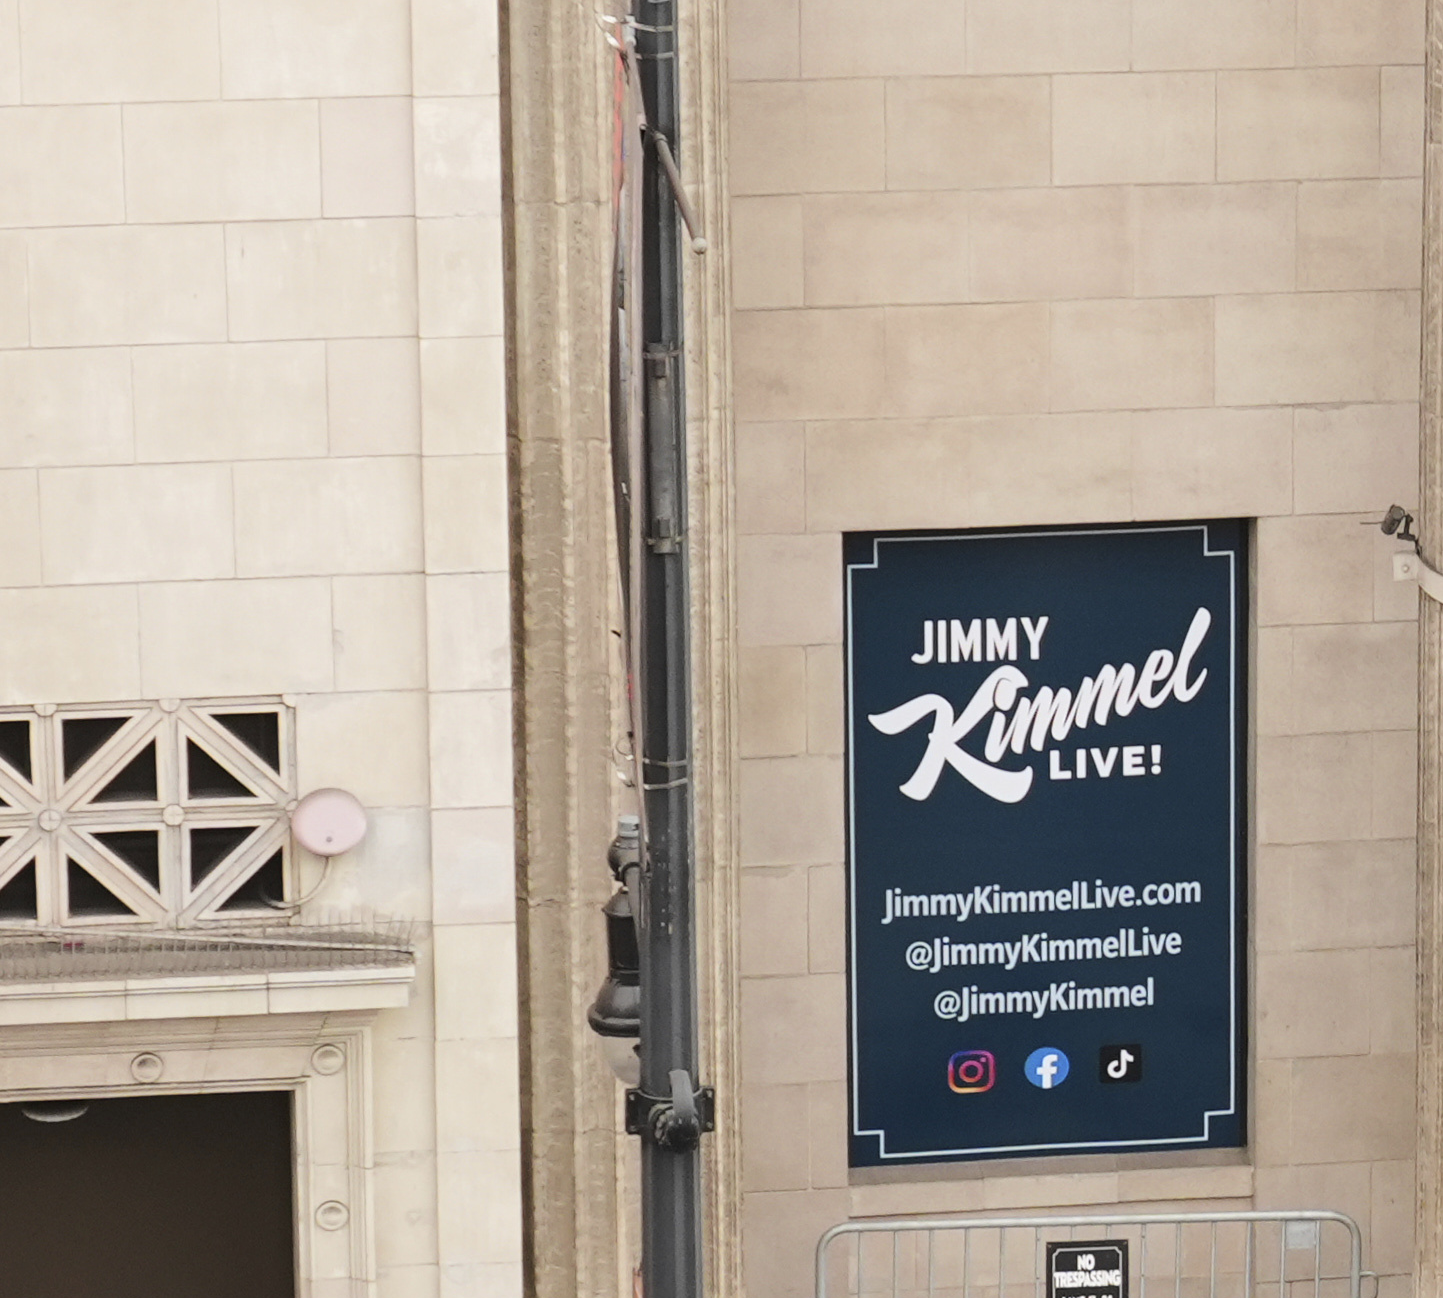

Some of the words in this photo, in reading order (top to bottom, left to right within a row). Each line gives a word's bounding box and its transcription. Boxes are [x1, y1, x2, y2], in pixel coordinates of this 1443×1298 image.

[910, 615, 1050, 666] JIMMY
[868, 607, 1212, 804] Kimmel
[1048, 744, 1163, 781] LIVE!
[881, 878, 1202, 925] JimmyKimmelLive.com
[905, 929, 1183, 974] @JimmyKimmelLive
[933, 977, 1155, 1022] @JimmyKimmel
[1053, 1270, 1122, 1288] TRESPASSING
[1077, 1253, 1096, 1270] NO
